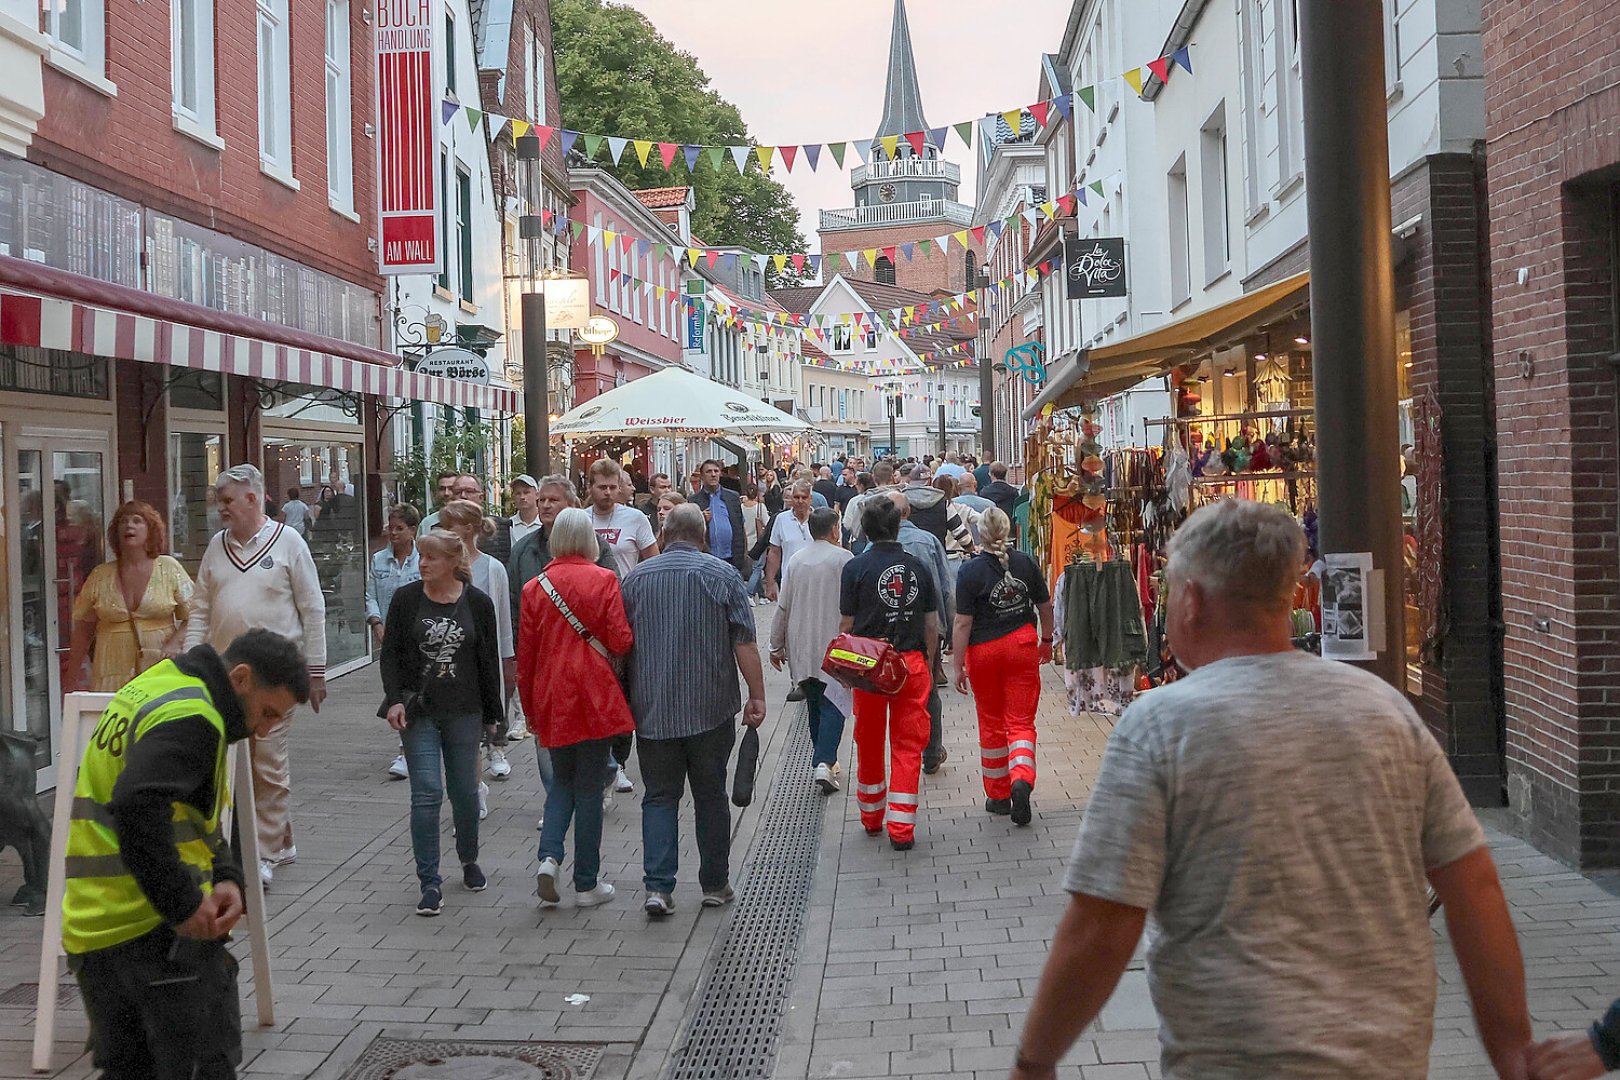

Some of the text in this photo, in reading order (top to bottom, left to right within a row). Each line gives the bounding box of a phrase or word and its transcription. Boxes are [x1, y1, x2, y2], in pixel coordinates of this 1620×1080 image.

[377, 0, 430, 28] BUCH
[377, 28, 431, 50] HANDLUNG
[386, 239, 432, 262] AM WALL
[446, 366, 486, 379] Börse
[625, 416, 687, 427] Weissbier
